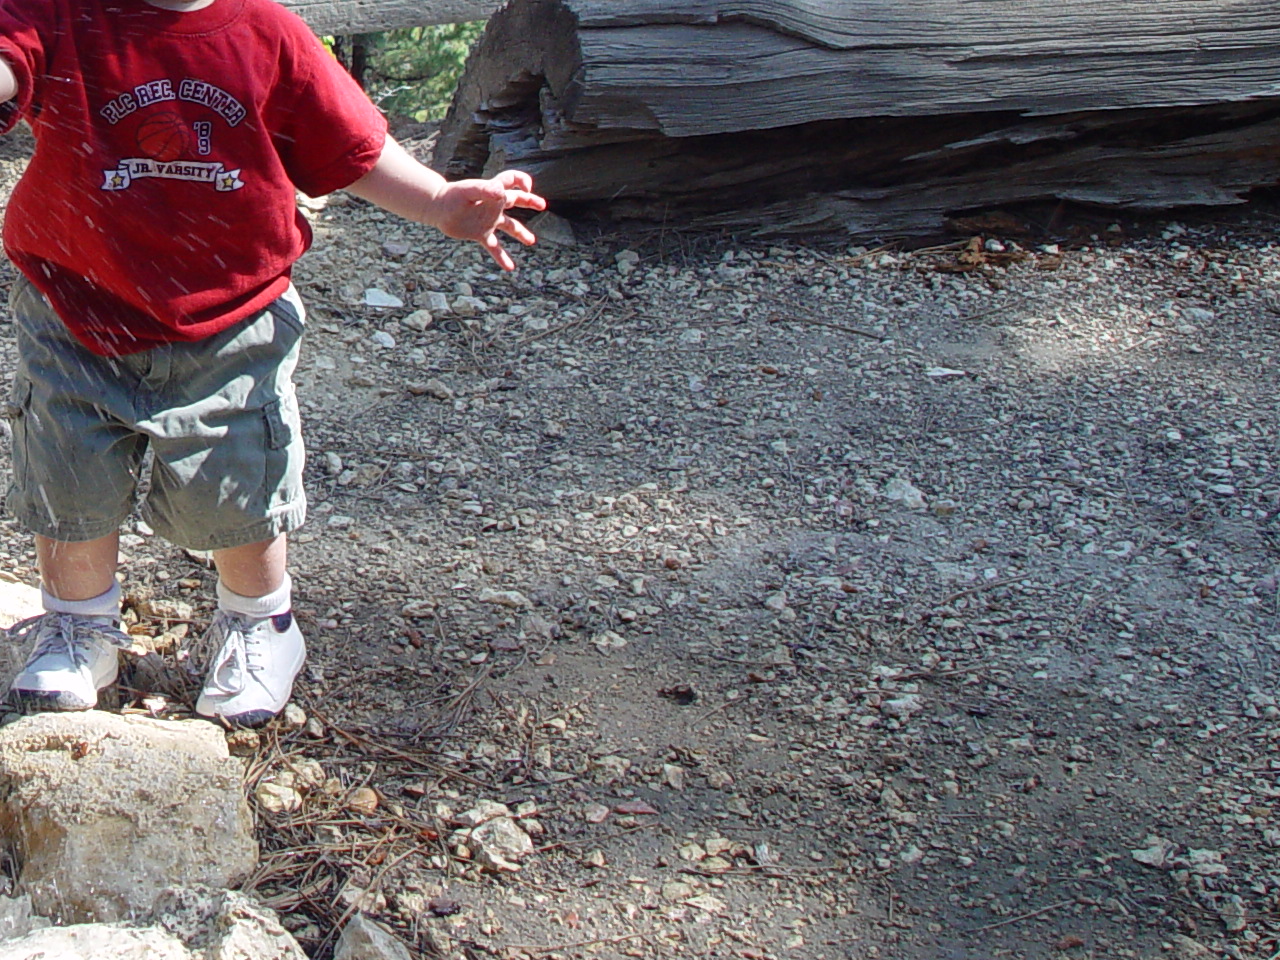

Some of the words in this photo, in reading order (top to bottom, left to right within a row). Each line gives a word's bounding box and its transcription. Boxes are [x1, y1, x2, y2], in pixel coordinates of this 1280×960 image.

[100, 93, 138, 125] PLC
[135, 79, 176, 107] REC.
[179, 79, 247, 127] CENTER
[156, 164, 214, 179] VARSITY
